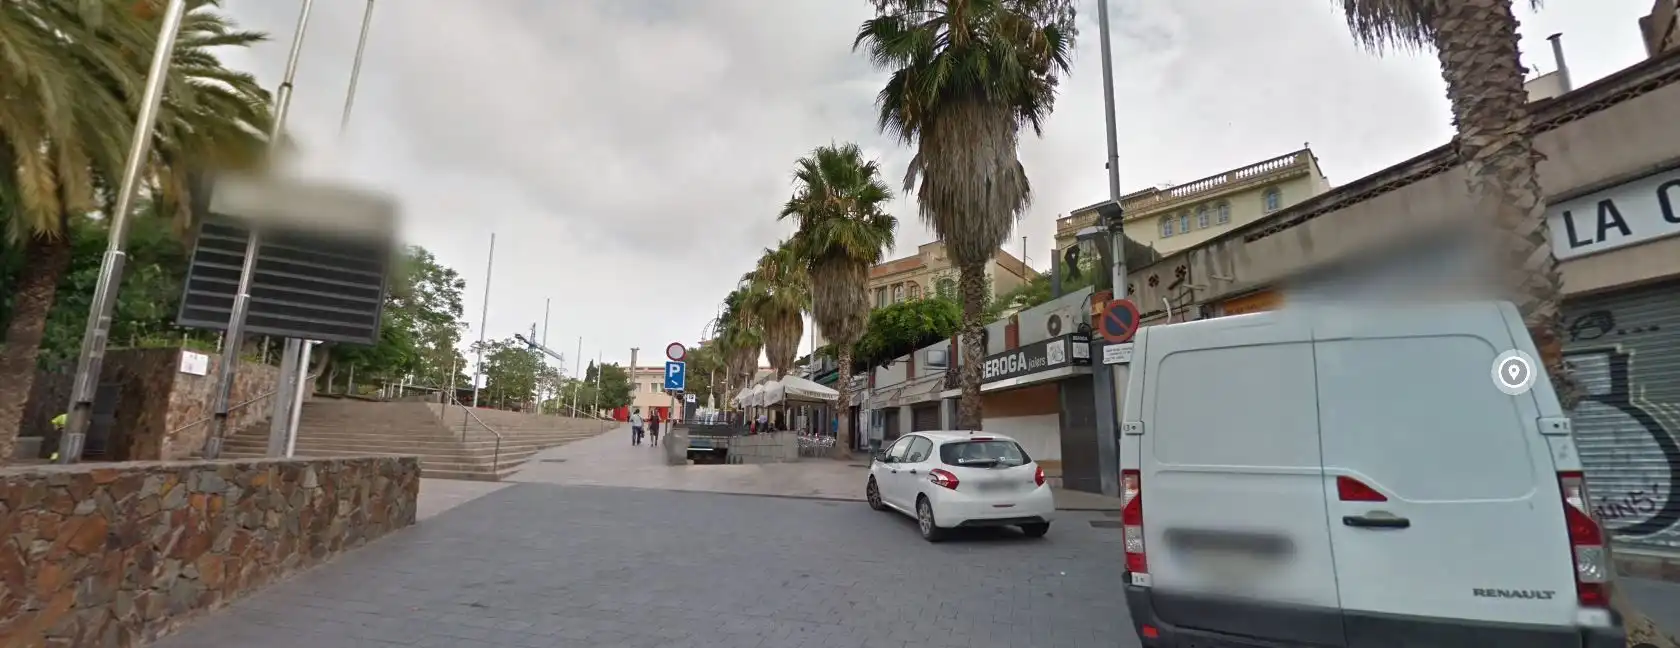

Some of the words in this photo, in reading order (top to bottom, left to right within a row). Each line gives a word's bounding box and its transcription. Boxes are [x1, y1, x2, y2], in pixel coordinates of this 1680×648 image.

[1563, 199, 1632, 248] LA
[669, 363, 681, 377] P
[1472, 588, 1556, 600] RENAULT
